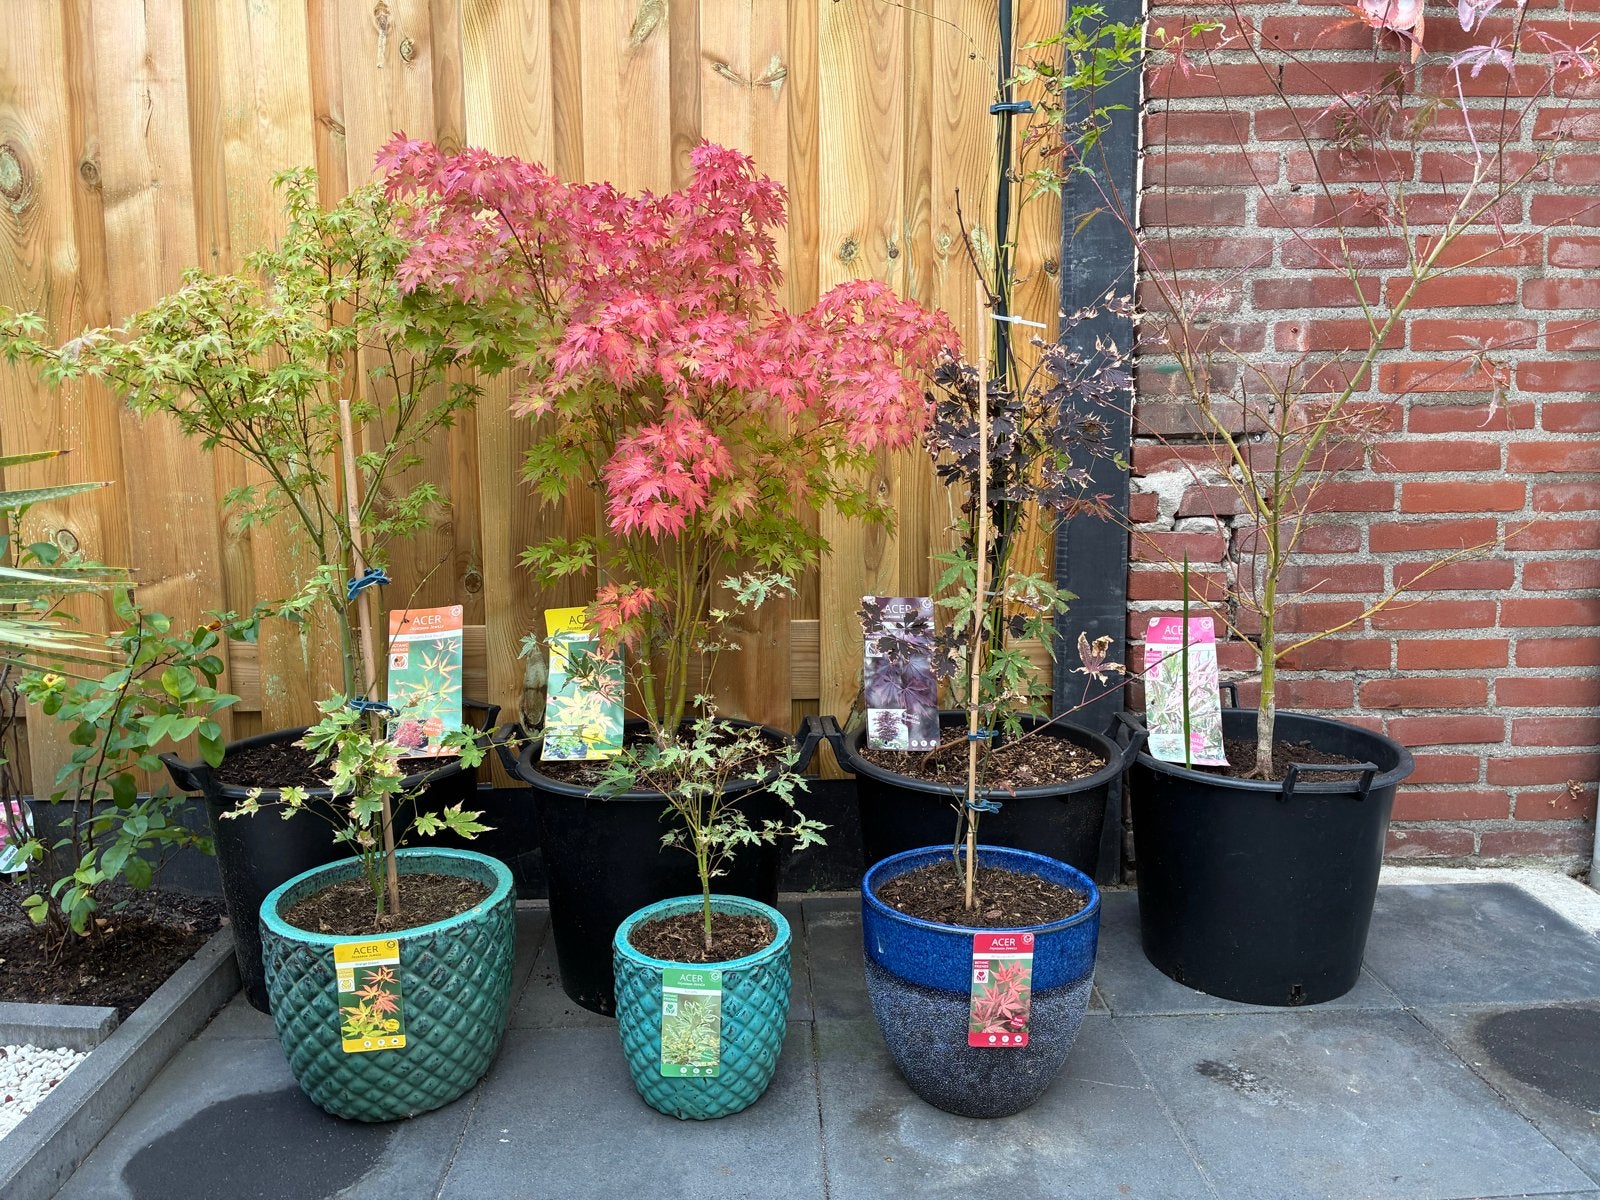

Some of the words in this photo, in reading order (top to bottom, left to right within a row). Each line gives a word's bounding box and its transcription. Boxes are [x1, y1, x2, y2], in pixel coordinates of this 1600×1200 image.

[412, 614, 442, 625] ACER
[991, 938, 1016, 947] ACER
[353, 946, 379, 955] ACER
[679, 974, 704, 982] ACER
